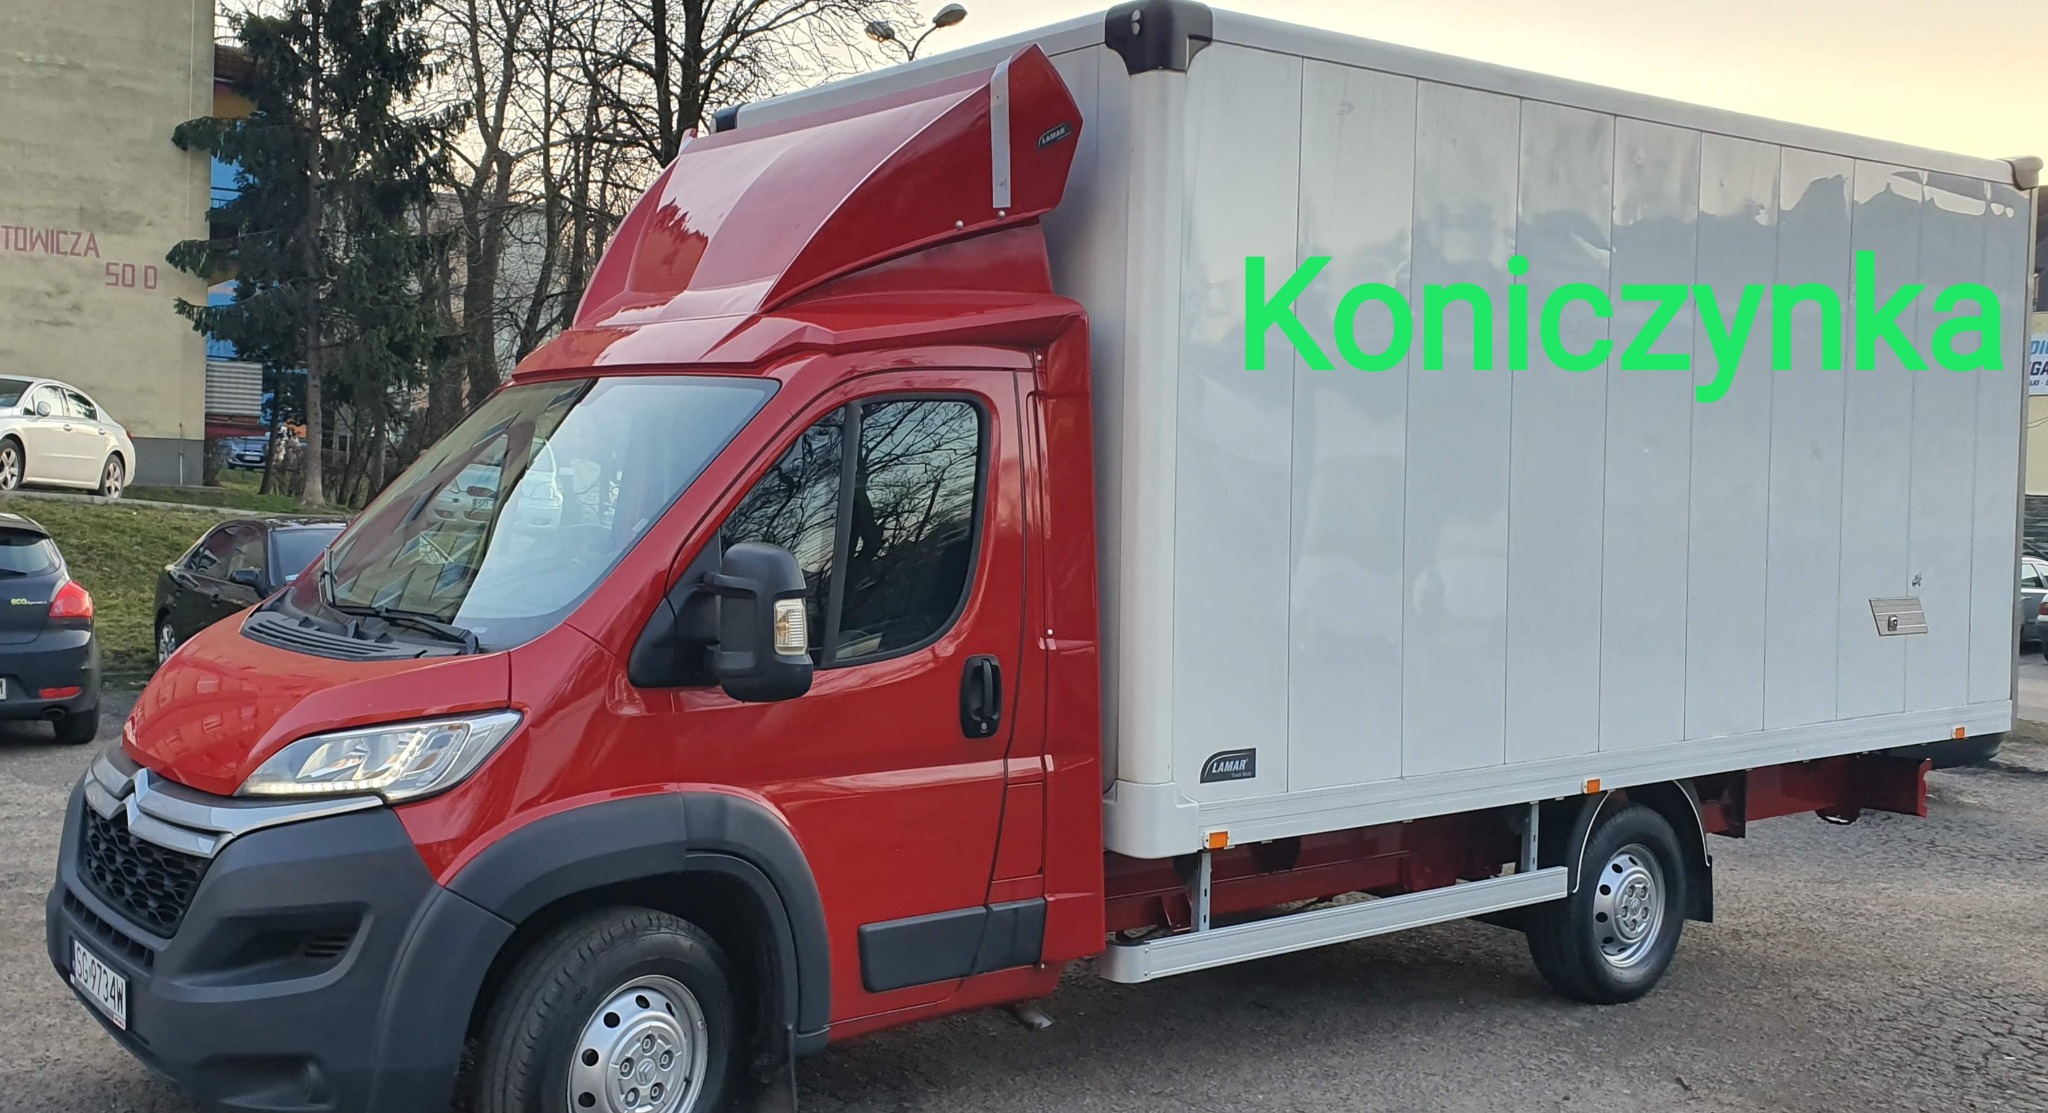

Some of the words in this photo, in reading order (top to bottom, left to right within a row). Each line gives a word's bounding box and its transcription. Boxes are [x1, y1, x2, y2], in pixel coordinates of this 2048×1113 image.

[1042, 126, 1066, 145] LAMAR
[1, 225, 100, 258] TOWICZA
[105, 262, 136, 288] 50
[144, 265, 158, 290] D
[1211, 759, 1247, 774] LAMAR
[91, 959, 124, 1016] 9734W
